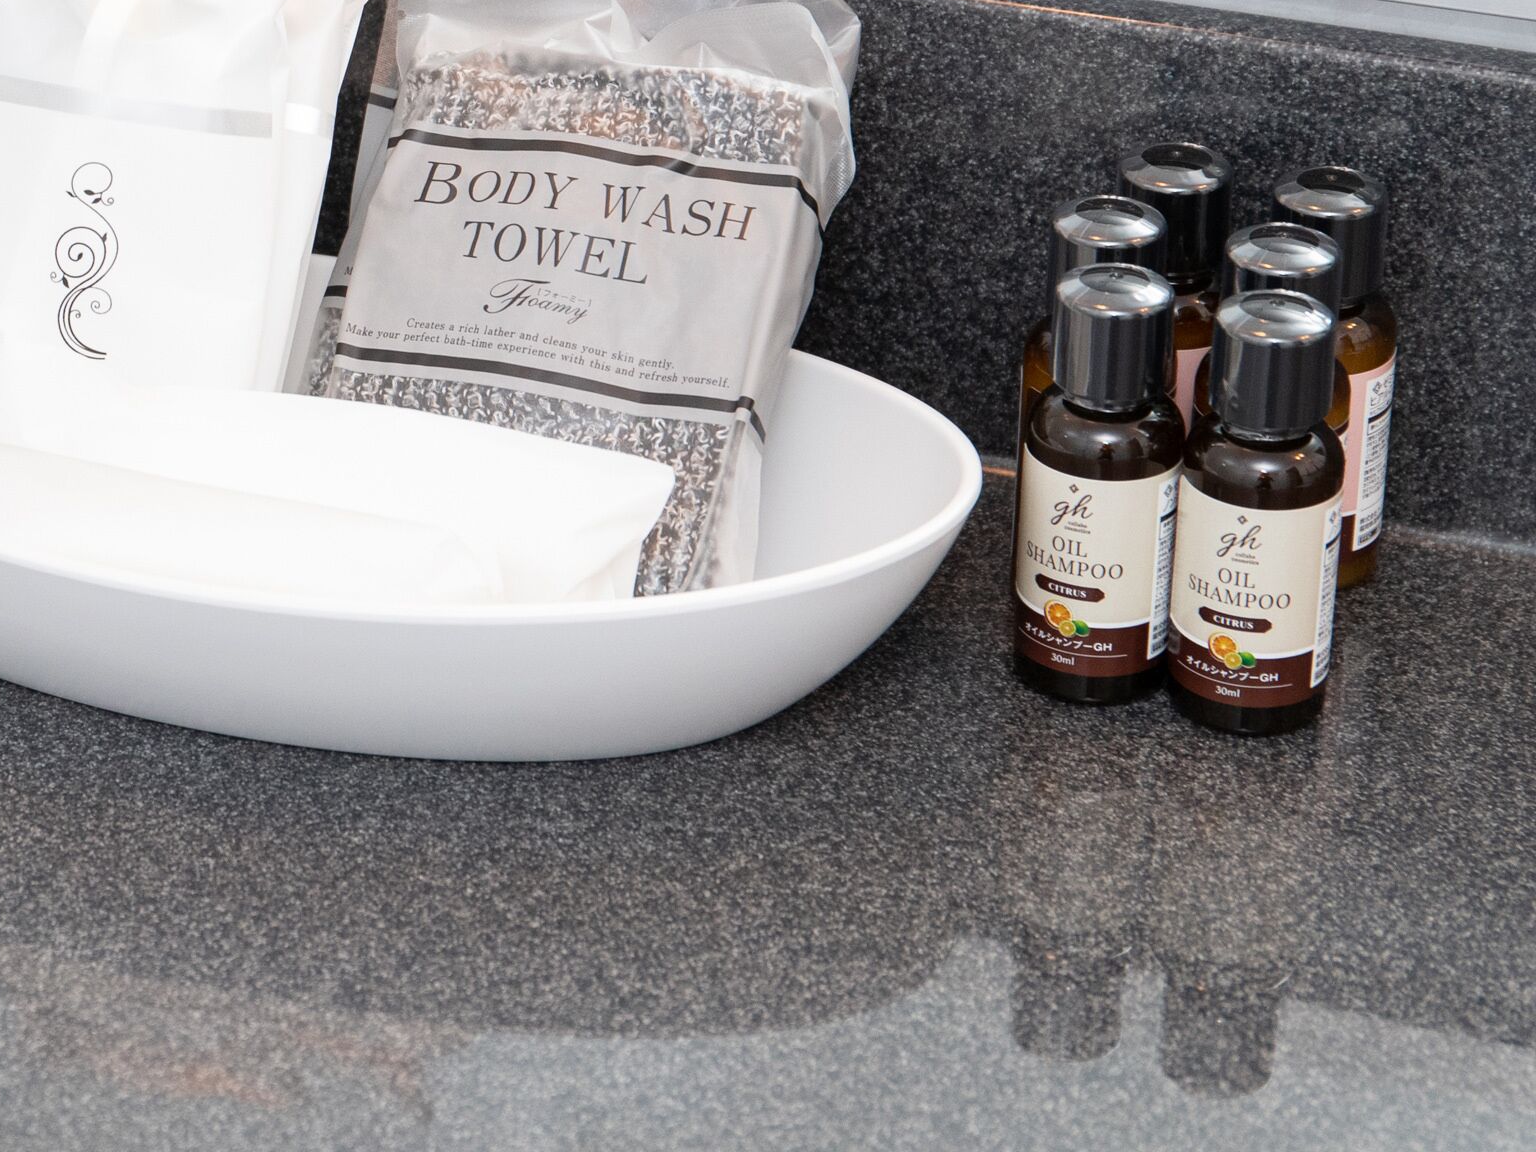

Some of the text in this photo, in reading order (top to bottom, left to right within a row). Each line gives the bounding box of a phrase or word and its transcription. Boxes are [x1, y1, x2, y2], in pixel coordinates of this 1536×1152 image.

[413, 160, 758, 242] BODY WASH
[461, 219, 649, 285] TOWEL
[483, 278, 589, 325] Foamy
[345, 322, 731, 389] Make your perfect bath-time experience with this and refresh yourself.
[406, 317, 445, 331] Creates
[458, 321, 480, 335] rich
[484, 325, 516, 339] lather
[519, 328, 539, 342] and
[542, 335, 577, 350] cleans
[581, 346, 608, 358] your
[611, 350, 634, 364] skin
[638, 357, 675, 371] gently.
[1050, 494, 1094, 525] gh
[1052, 535, 1088, 558] OIL
[1216, 525, 1263, 557] gh
[1026, 540, 1124, 580] SHAMPOO
[1048, 582, 1087, 598] CITRUS
[1188, 573, 1292, 610] SHAMPOO
[1218, 567, 1256, 589] OIL
[1212, 614, 1254, 630] CITRUS
[1051, 652, 1075, 666] 30ml
[1215, 685, 1241, 698] 30ml
